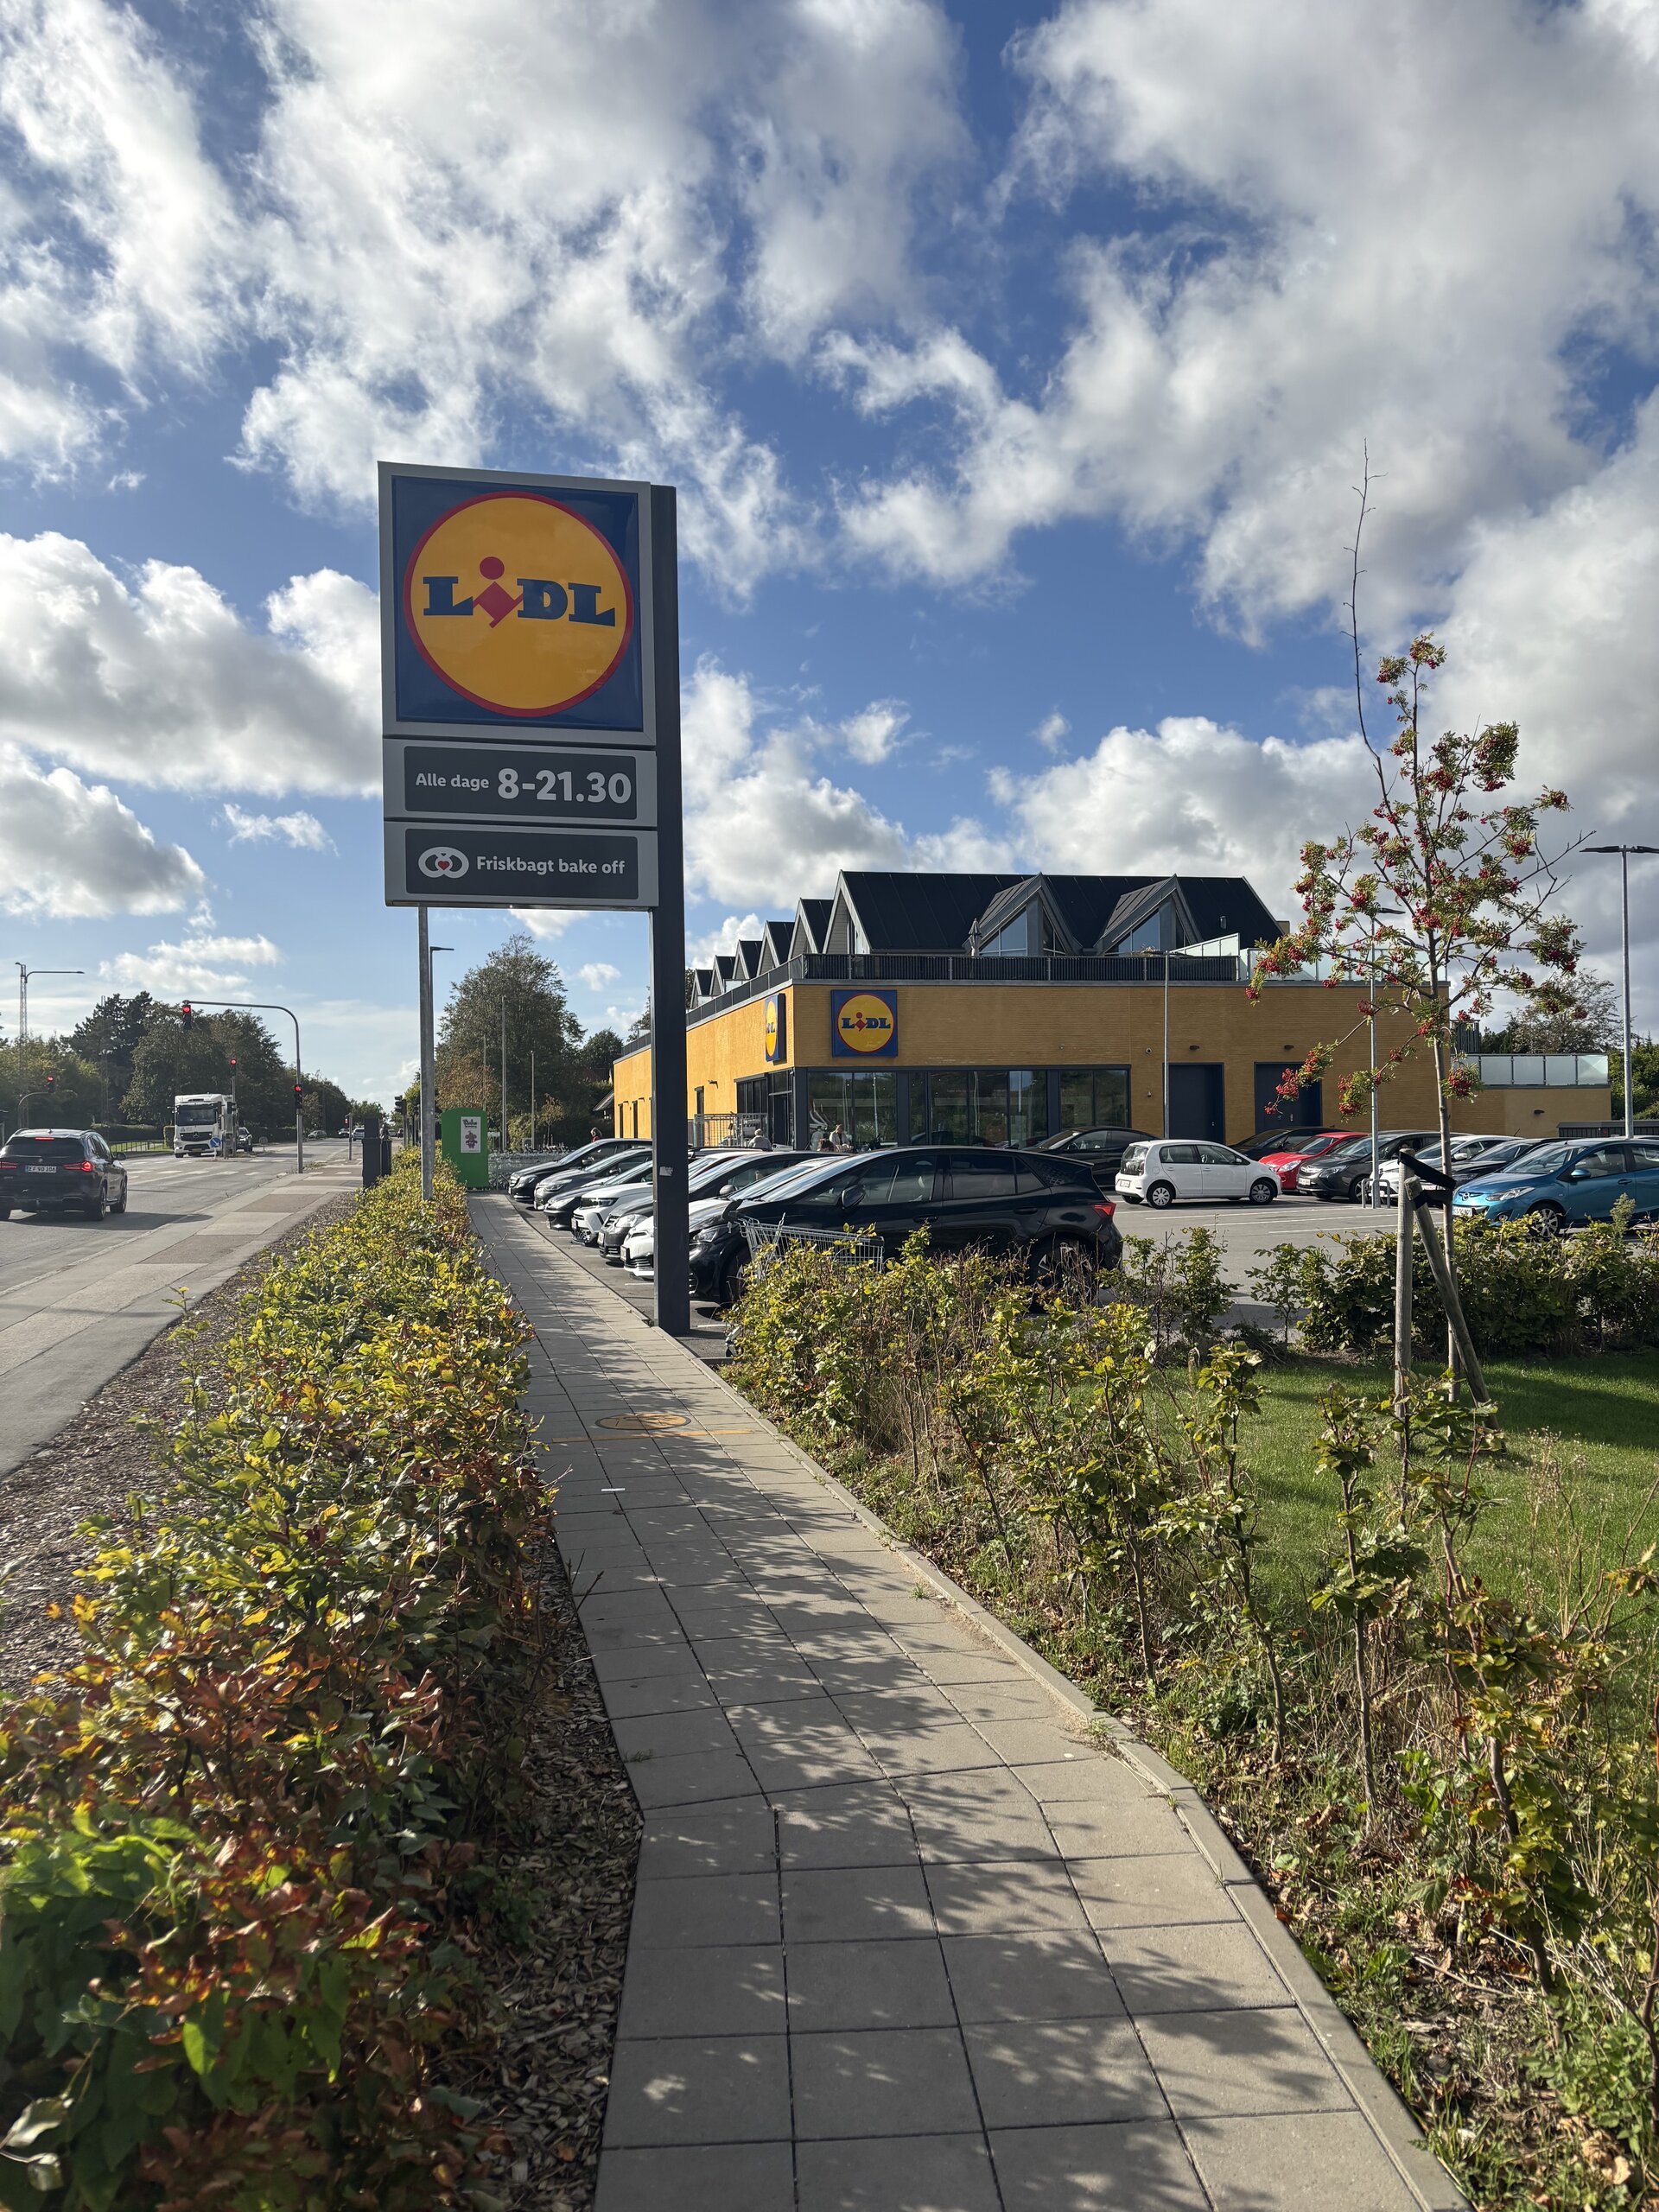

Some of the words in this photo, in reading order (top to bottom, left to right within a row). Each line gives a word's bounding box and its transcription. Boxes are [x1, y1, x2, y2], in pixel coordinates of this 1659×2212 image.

[415, 773, 447, 787] Alle
[450, 774, 490, 791] dage
[498, 768, 632, 804] 8-21.30
[476, 855, 554, 875] Friskbagt
[558, 858, 597, 874] bake
[601, 860, 625, 874] off
